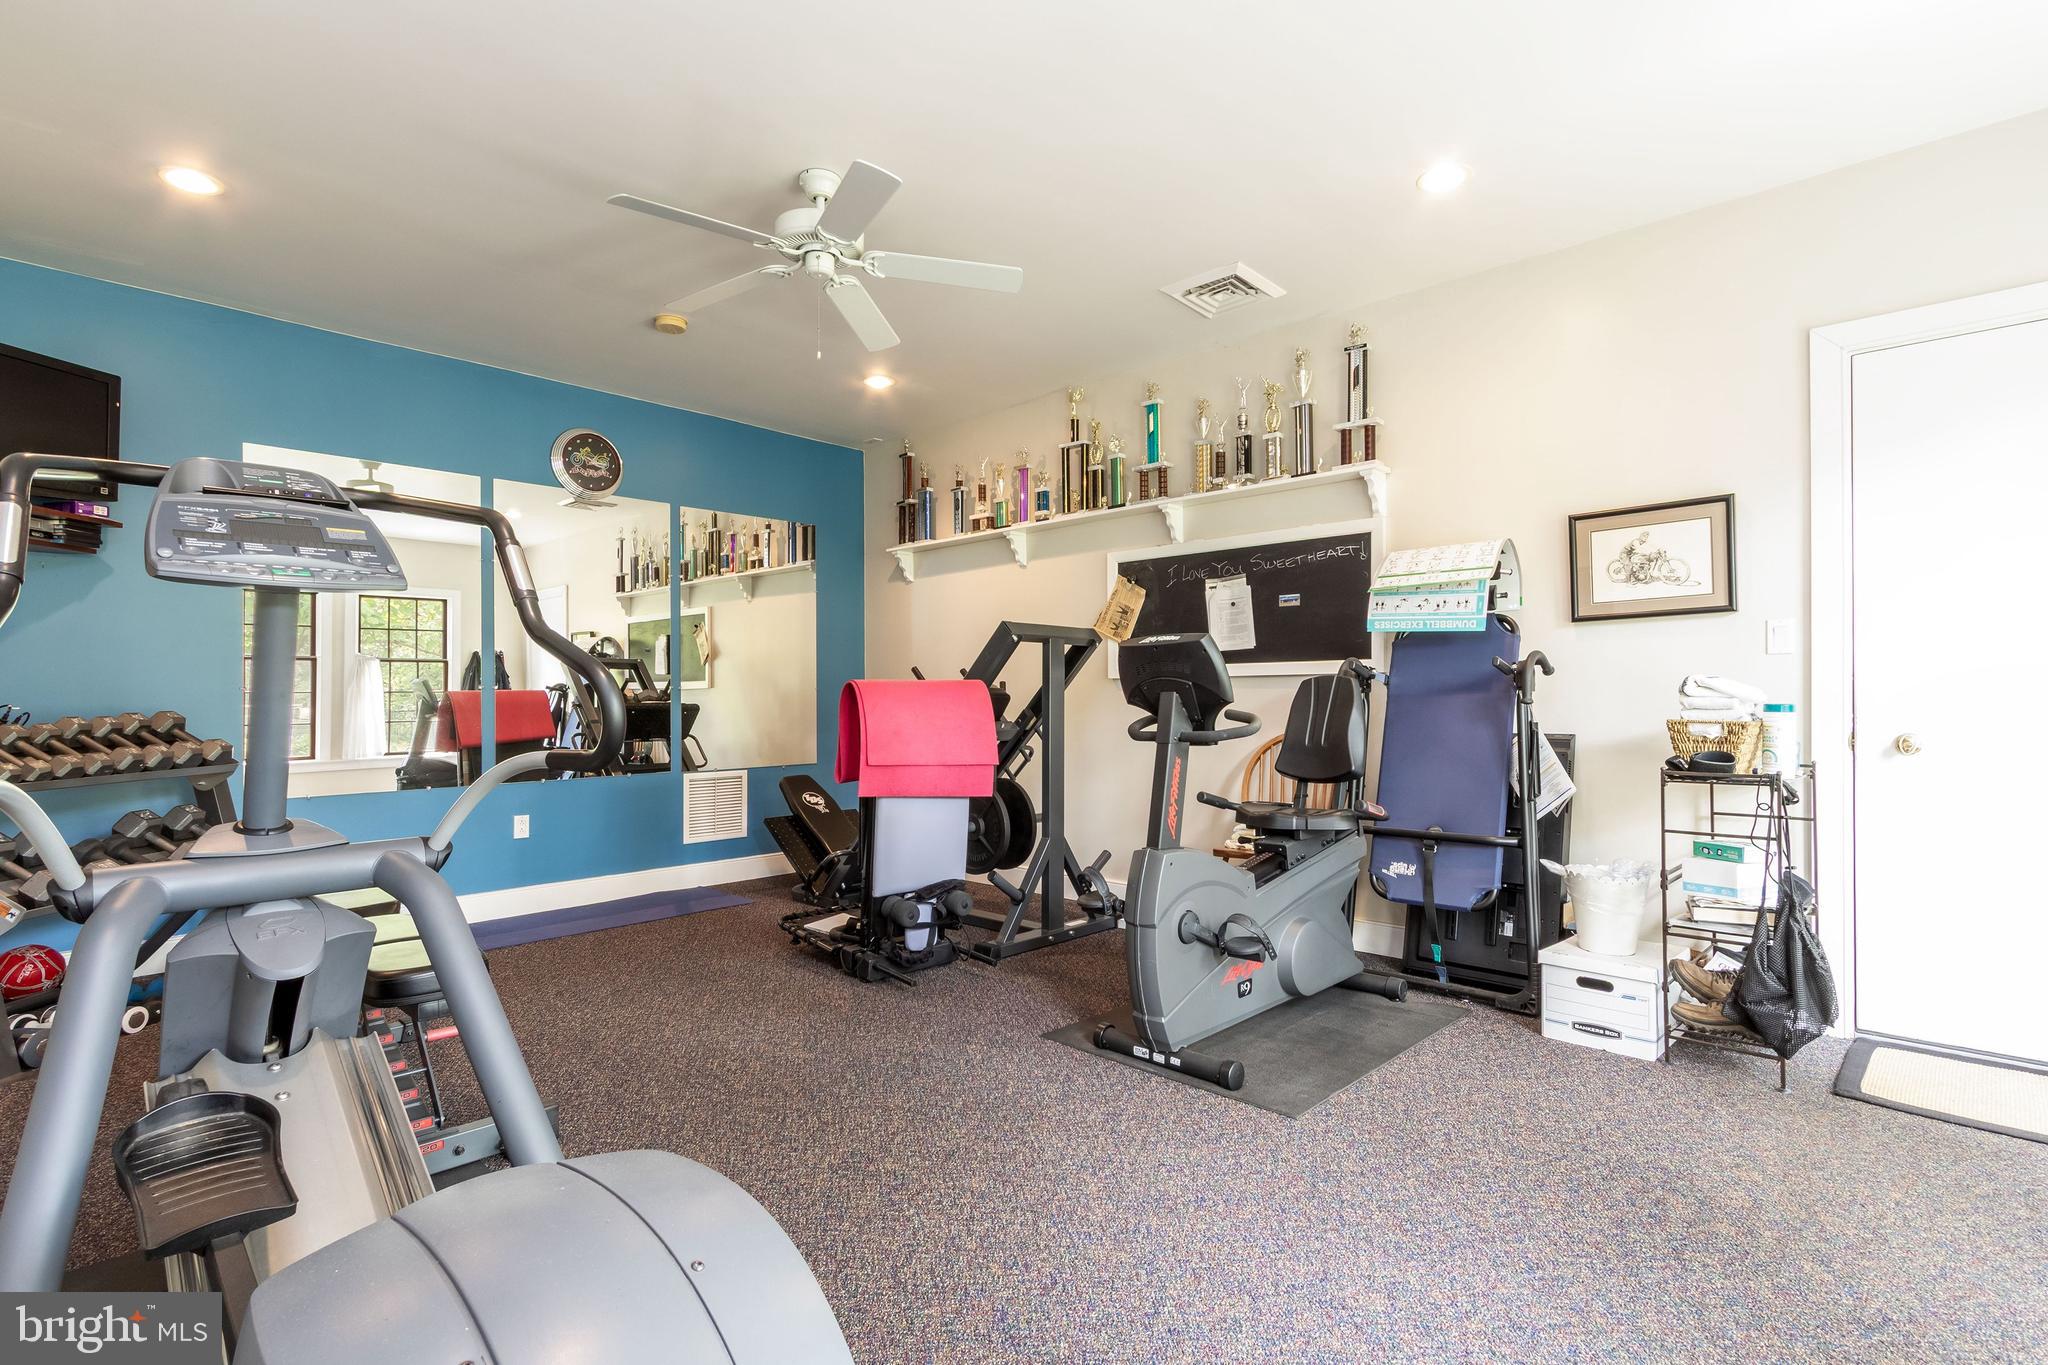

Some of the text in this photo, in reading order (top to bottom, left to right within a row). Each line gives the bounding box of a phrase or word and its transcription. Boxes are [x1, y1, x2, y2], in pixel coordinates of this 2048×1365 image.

[1166, 564, 1178, 588] I
[1374, 620, 1477, 629] DUMBBELL EXERCISES
[1574, 1024, 1619, 1038] BANKERS BOX
